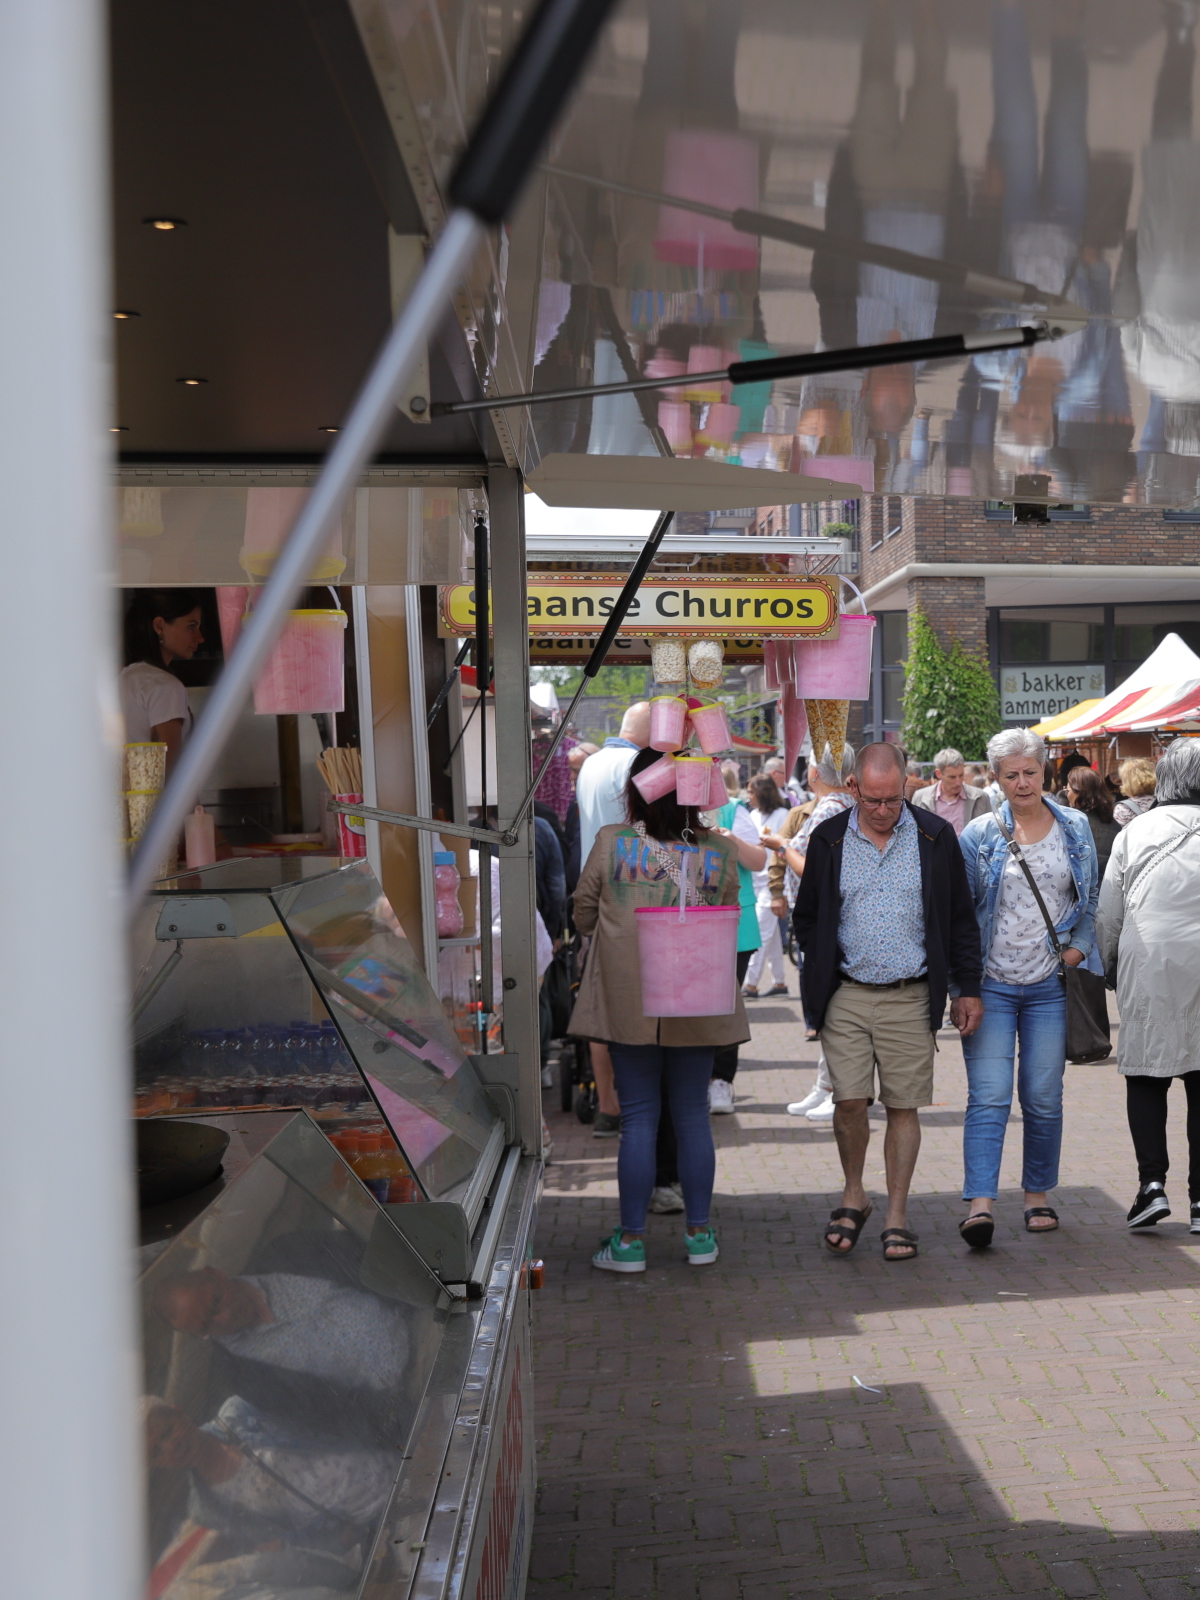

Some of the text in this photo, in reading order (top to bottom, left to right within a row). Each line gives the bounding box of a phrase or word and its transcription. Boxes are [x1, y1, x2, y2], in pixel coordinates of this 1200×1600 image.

[468, 589, 814, 619] aanse Churros
[1022, 671, 1085, 693] bakker
[1005, 696, 1087, 715] ammerl
